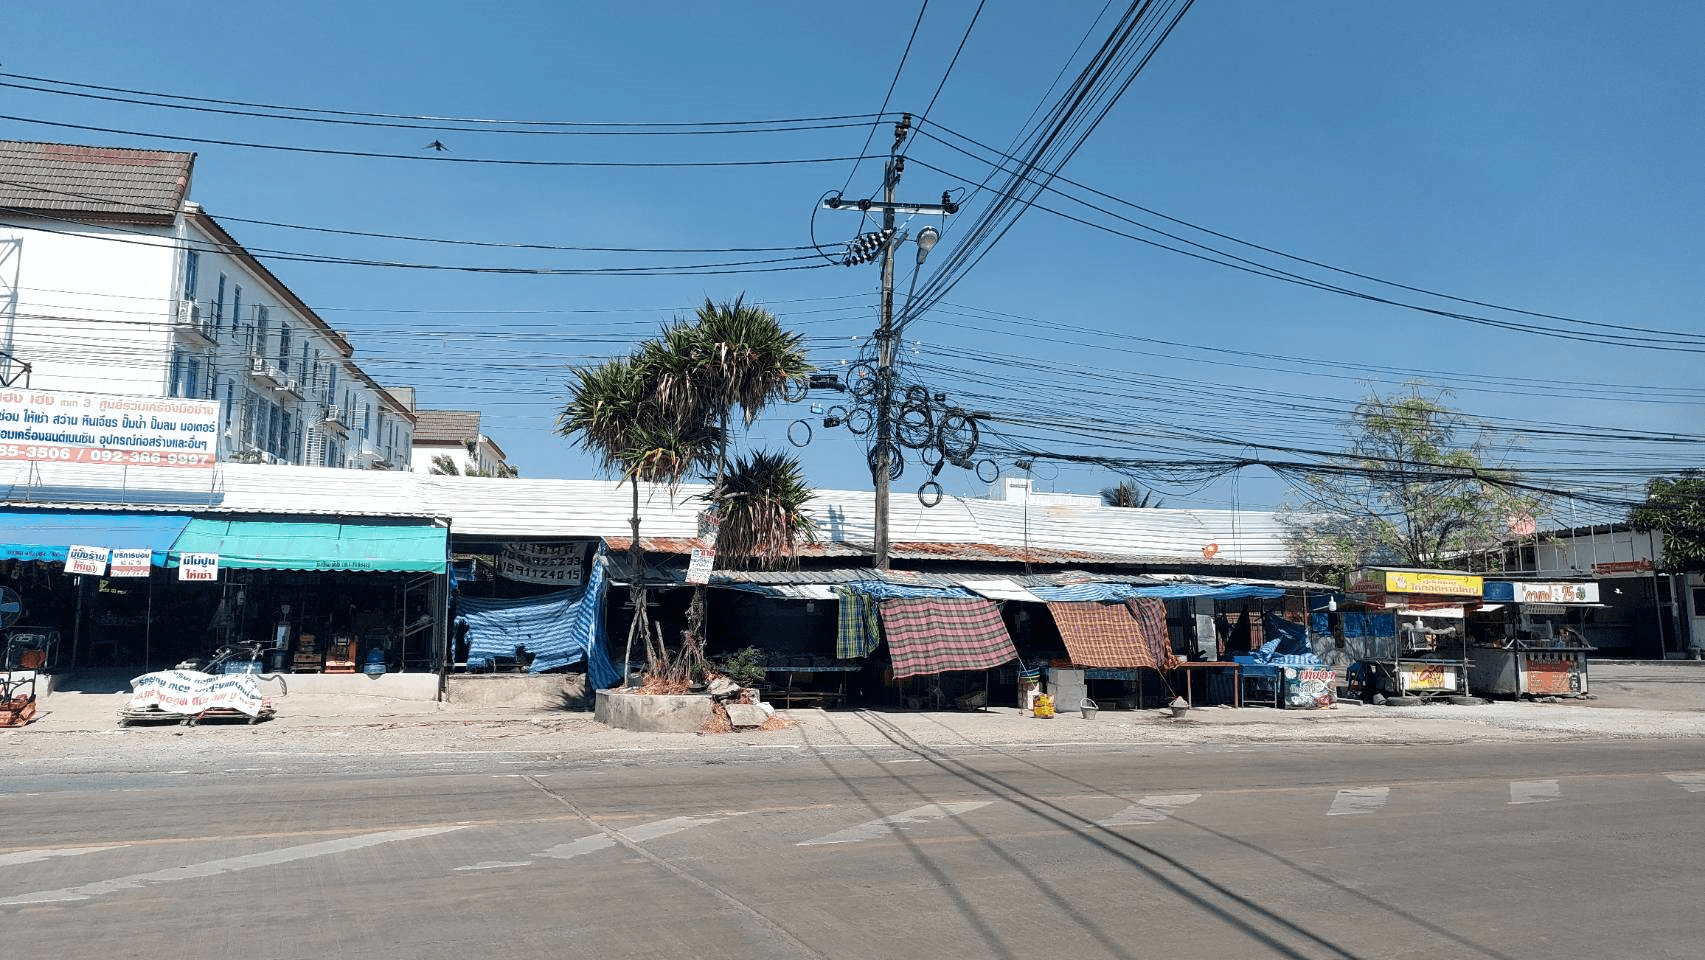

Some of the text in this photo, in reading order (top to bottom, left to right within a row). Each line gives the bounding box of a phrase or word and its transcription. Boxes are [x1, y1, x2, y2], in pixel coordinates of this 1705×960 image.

[83, 398, 91, 408] 3
[24, 409, 48, 424] ให้เช่า
[53, 413, 78, 426] สว่าน
[82, 414, 118, 427] หินเจียร
[122, 414, 147, 429] ปั๊มน้ำ
[150, 415, 176, 431] ปั๊มลม
[180, 421, 216, 433] มอเตอร์
[0, 426, 95, 444] อมเครื่องยนต์เบนซิน
[90, 449, 209, 464] 092-386-9997
